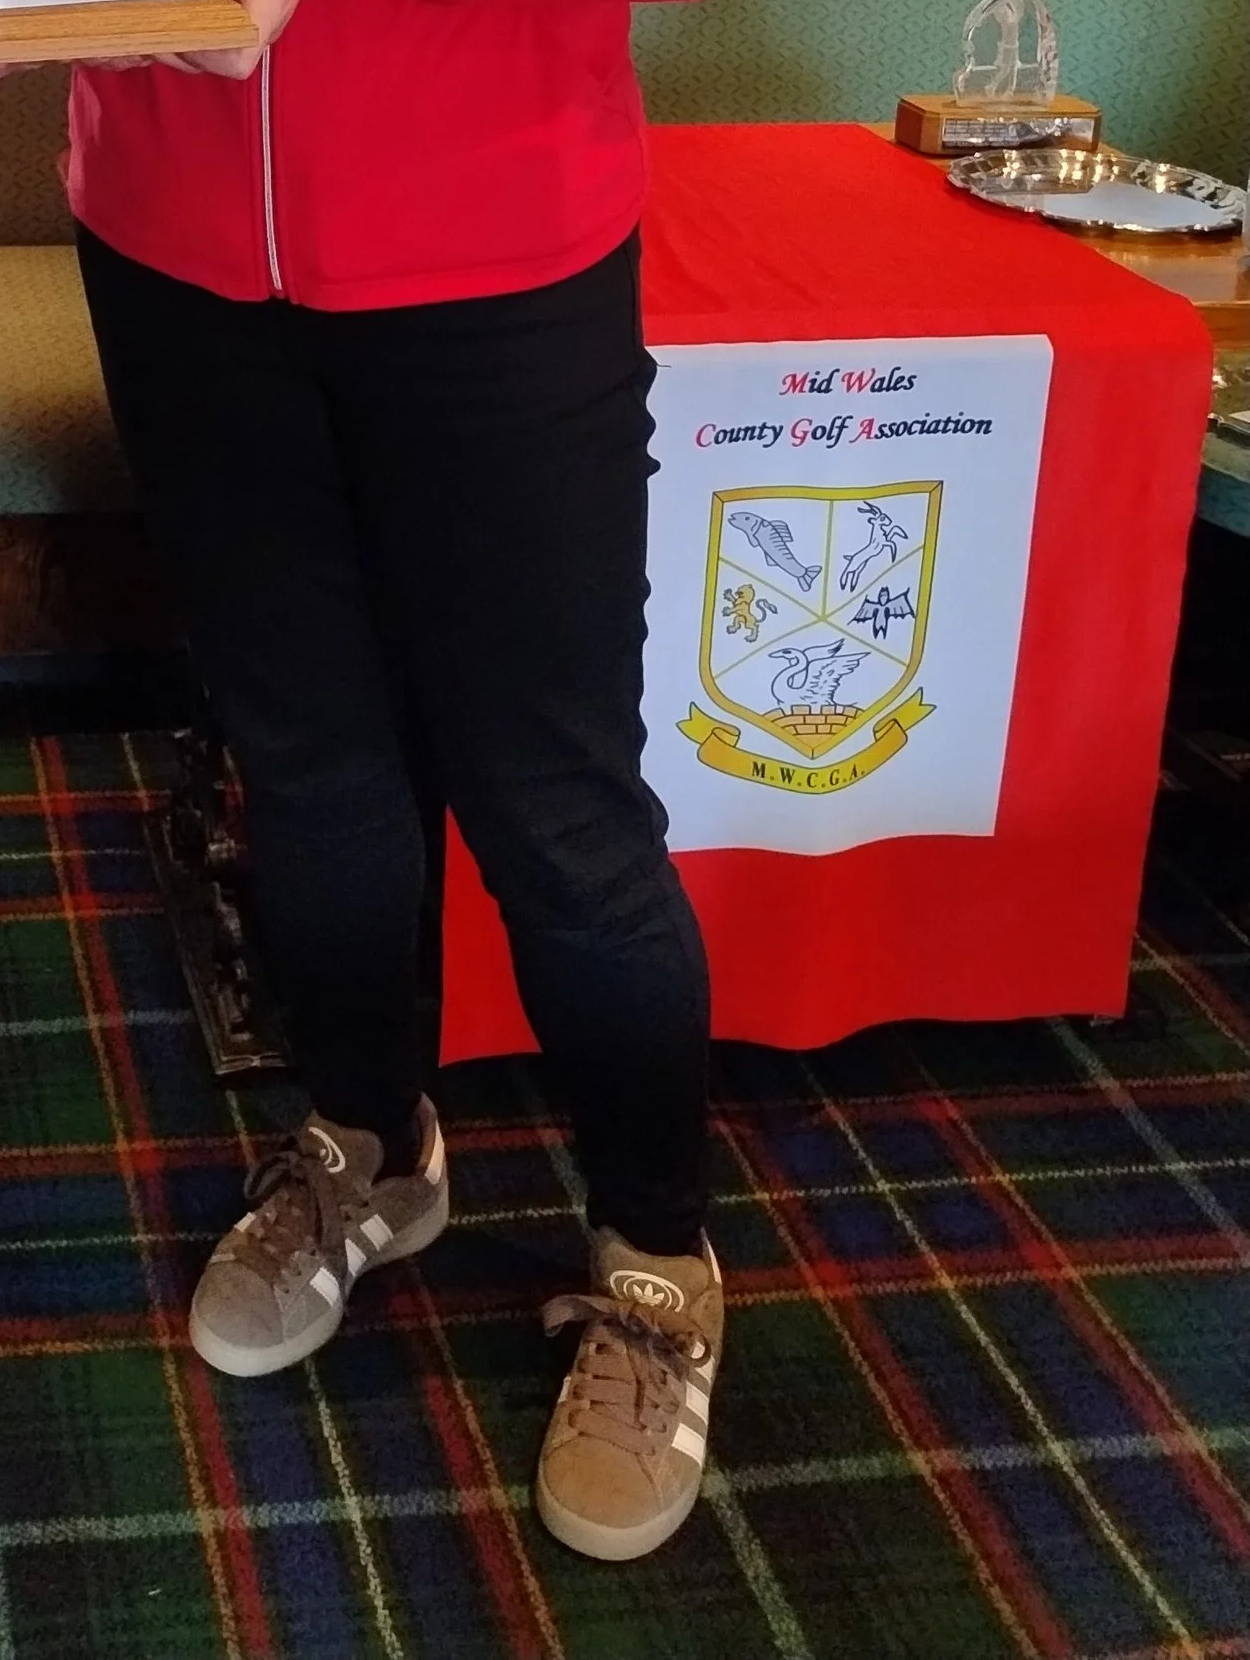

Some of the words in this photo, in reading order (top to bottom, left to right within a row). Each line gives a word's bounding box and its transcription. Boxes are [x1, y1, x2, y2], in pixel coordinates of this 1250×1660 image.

[779, 368, 840, 395] Mid
[841, 366, 917, 393] Wales
[696, 421, 784, 448] County
[790, 415, 854, 449] Golf
[849, 411, 993, 443] Association
